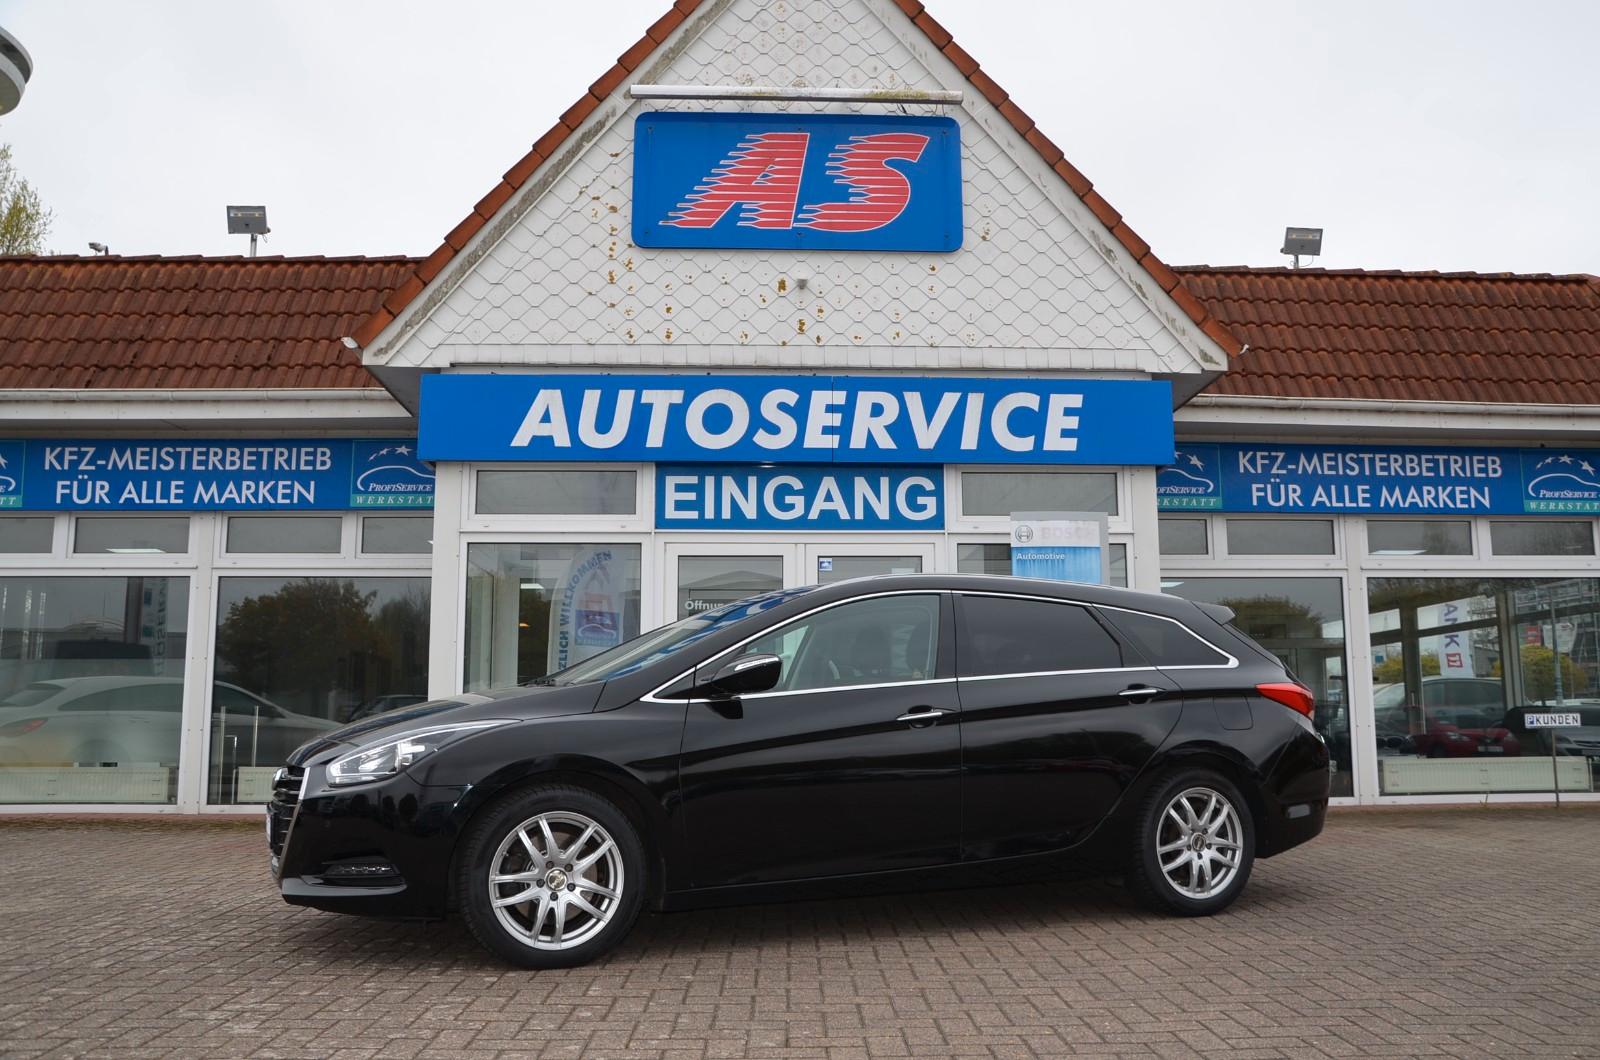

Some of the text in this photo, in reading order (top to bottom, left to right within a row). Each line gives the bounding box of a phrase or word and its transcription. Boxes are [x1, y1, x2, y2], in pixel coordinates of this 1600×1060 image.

[658, 132, 930, 232] AS
[510, 388, 1084, 452] AUTOSERVICE
[44, 447, 331, 471] KFZ-MEISTERBETRIEB
[1238, 451, 1503, 478] KFZ-MEISTERBETRIEB
[56, 474, 315, 505] FÜR ALLE MARKEN
[664, 475, 937, 521] EINGANG
[1251, 478, 1491, 510] FÜR ALLE MARKEN
[1016, 552, 1066, 560] Automotive
[684, 597, 725, 611] Öffnu
[1535, 714, 1579, 725] KUNDEN
